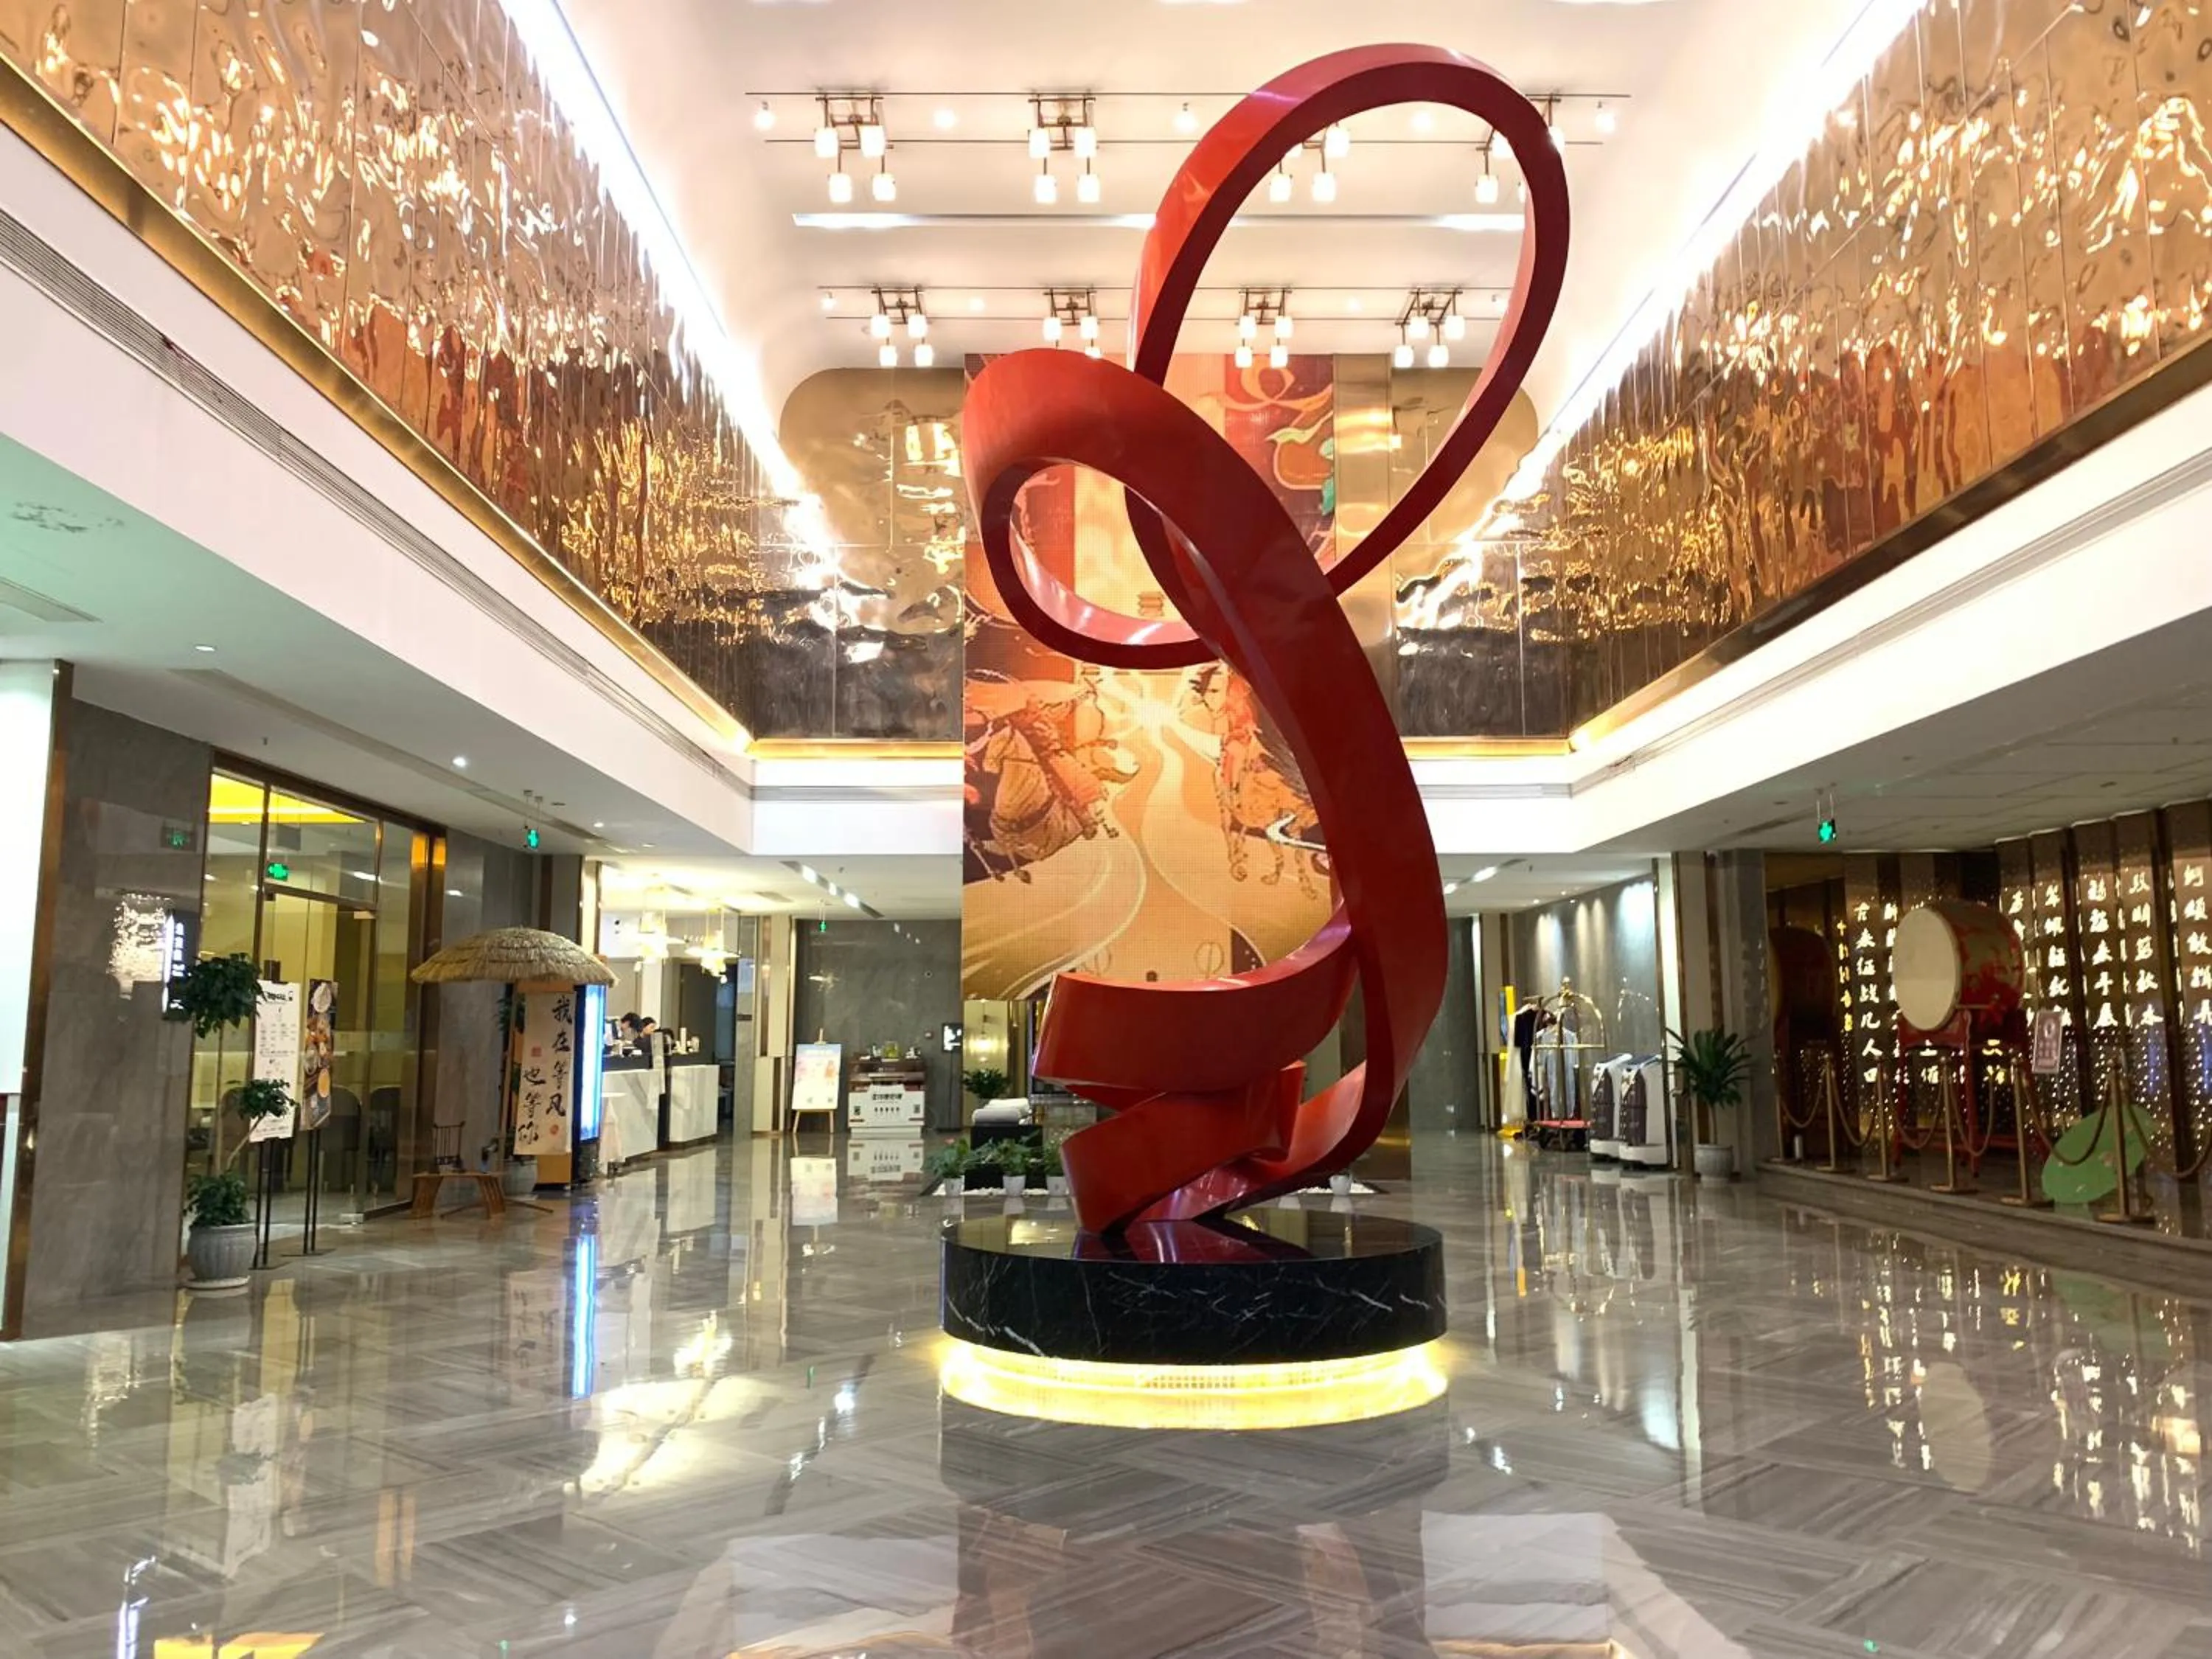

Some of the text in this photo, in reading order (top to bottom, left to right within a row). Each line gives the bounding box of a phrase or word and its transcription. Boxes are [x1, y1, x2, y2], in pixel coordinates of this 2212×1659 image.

[518, 1066, 546, 1145] 也等你
[546, 995, 572, 1117] 我在等风
